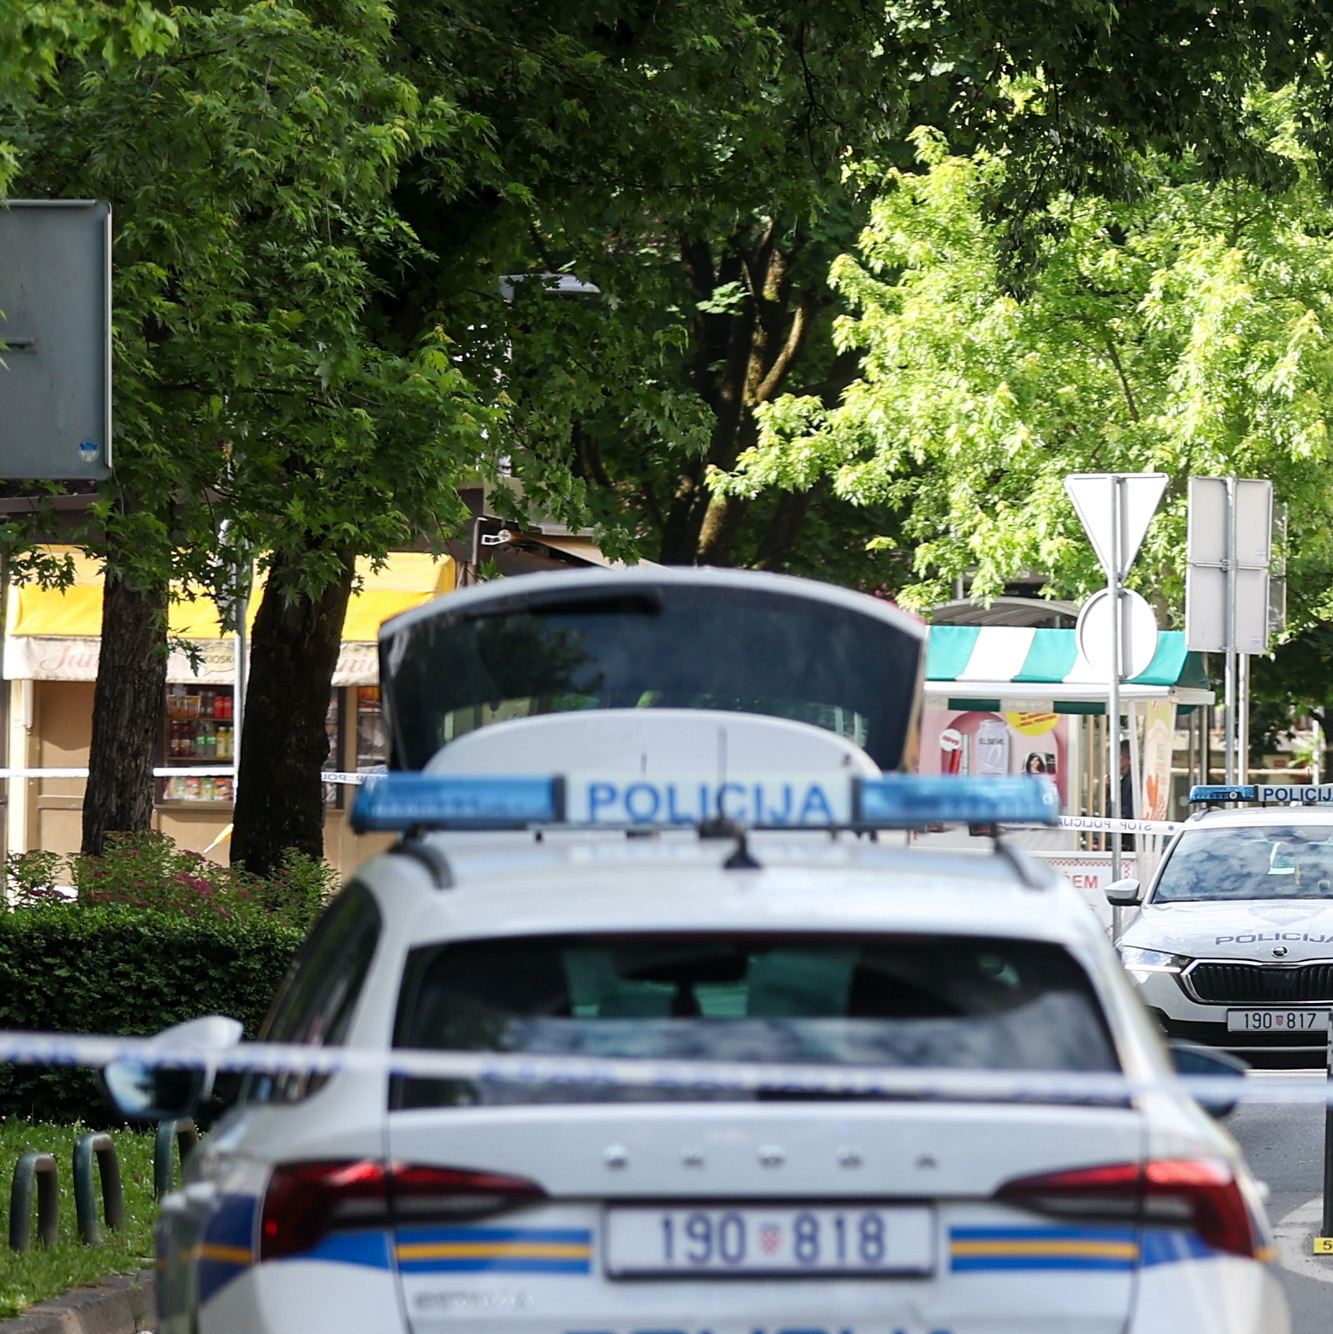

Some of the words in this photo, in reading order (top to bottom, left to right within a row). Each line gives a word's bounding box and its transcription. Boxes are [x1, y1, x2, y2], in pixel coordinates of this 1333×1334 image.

[587, 783, 835, 824] POLICIJA
[1244, 1013, 1272, 1029] 190
[1286, 1013, 1317, 1029] 817
[660, 1212, 747, 1267] 190
[793, 1212, 886, 1266] 818
[1323, 1240, 1332, 1250] 5
